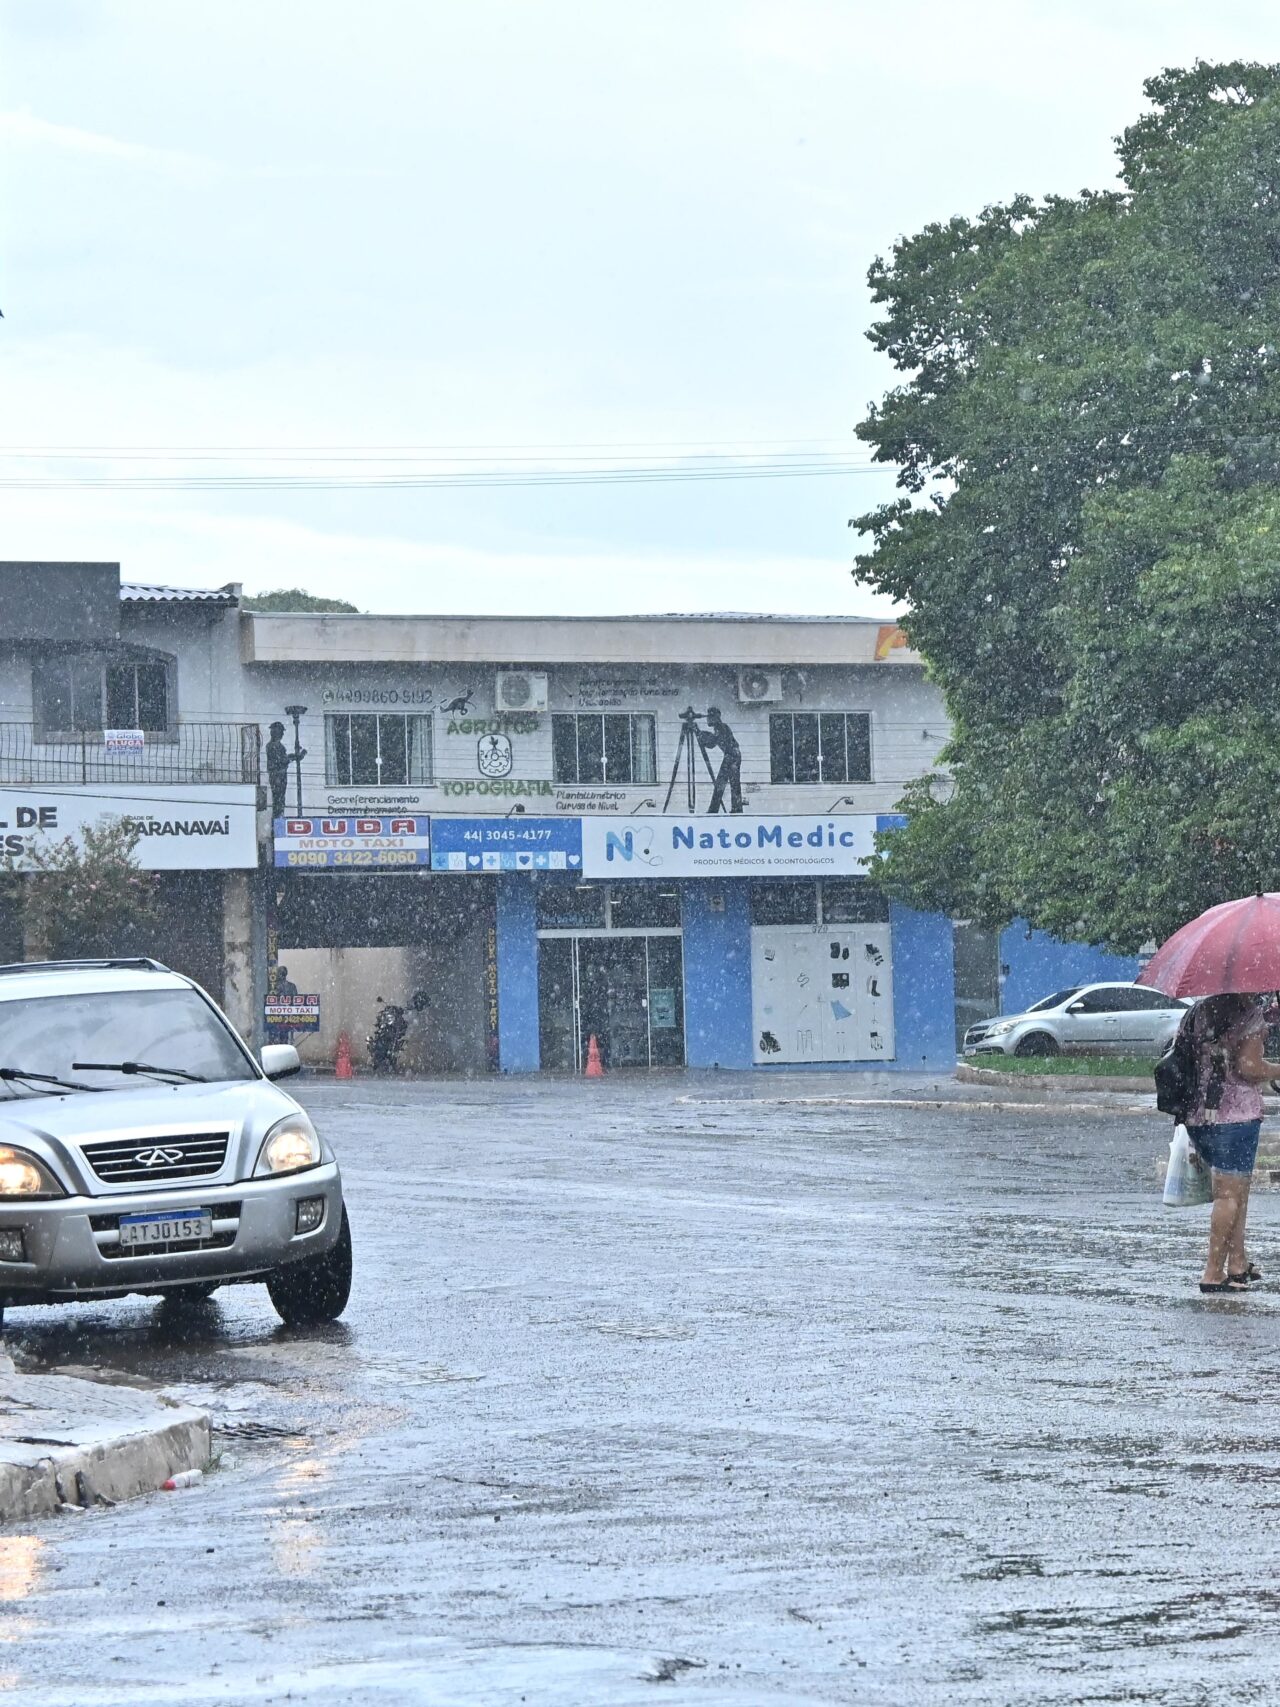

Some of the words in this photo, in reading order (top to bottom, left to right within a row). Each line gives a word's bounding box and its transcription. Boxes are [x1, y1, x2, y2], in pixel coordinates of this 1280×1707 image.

[442, 781, 554, 797] TOPOGRAFIA
[587, 801, 596, 810] de
[16, 806, 58, 828] DE
[121, 815, 230, 837] PARANAVAÍ
[286, 818, 417, 836] DUDA
[486, 829, 552, 841] 3045-4177
[672, 823, 855, 850] NatoMedic
[0, 835, 24, 857] S
[300, 839, 354, 848] MOTO
[361, 838, 404, 847] TAXI
[287, 852, 327, 865] 9090
[733, 856, 765, 865] MÉDICOS
[266, 995, 318, 1005] DUDA
